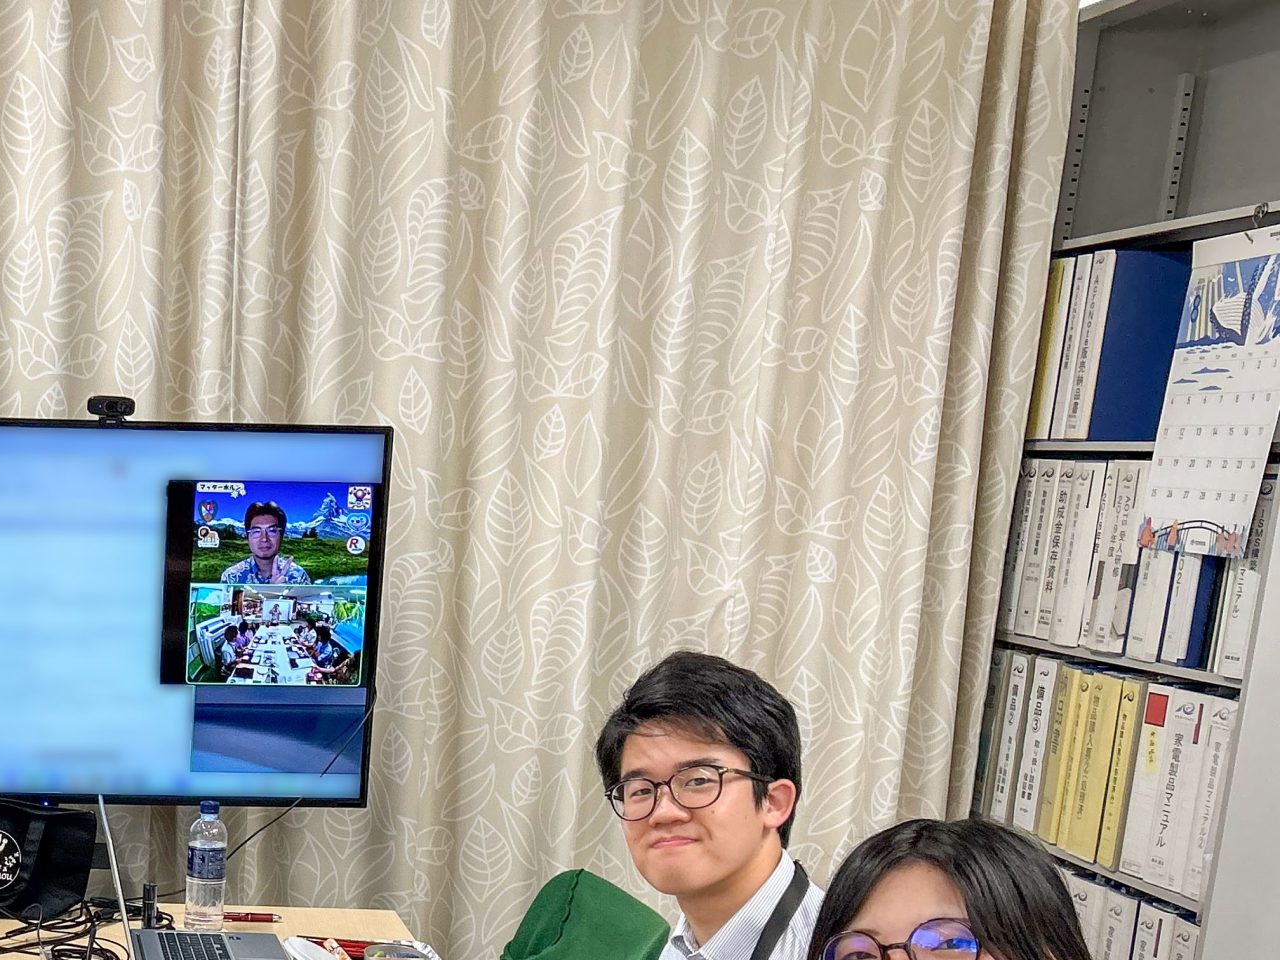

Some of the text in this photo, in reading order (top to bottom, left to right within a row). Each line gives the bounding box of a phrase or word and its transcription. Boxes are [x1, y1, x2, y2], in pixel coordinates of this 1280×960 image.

[1190, 294, 1201, 323] 8
[1175, 553, 1185, 597] 021
[1031, 685, 1047, 733] 備品③
[1155, 732, 1185, 849] 家電製品マニュアル
